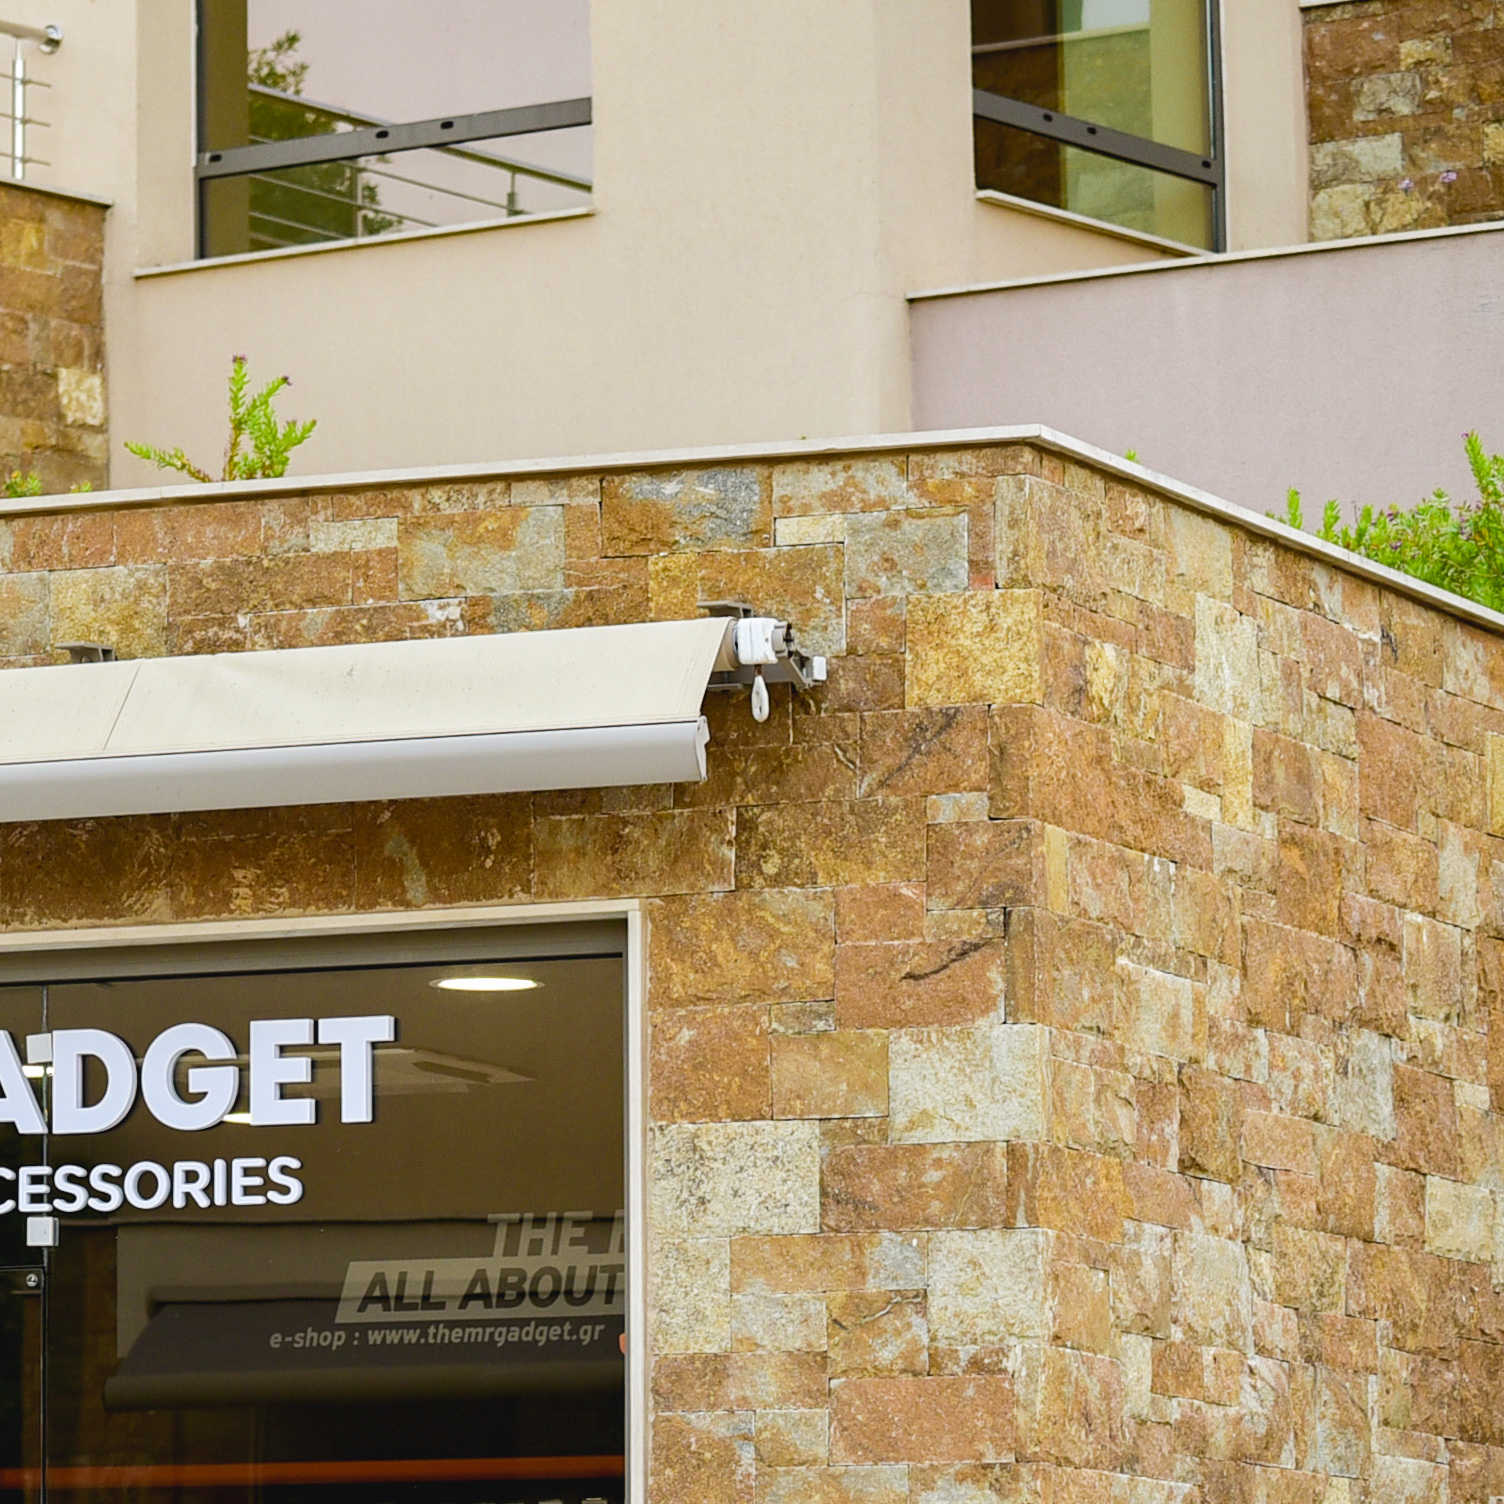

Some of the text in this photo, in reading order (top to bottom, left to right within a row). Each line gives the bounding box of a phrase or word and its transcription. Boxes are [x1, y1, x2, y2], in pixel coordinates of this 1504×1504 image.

[487, 1210, 593, 1257] THE
[356, 1264, 626, 1313] ALL ABOUT
[269, 1327, 346, 1350] e-shop
[367, 1320, 605, 1348] www.themrgadget.gr
